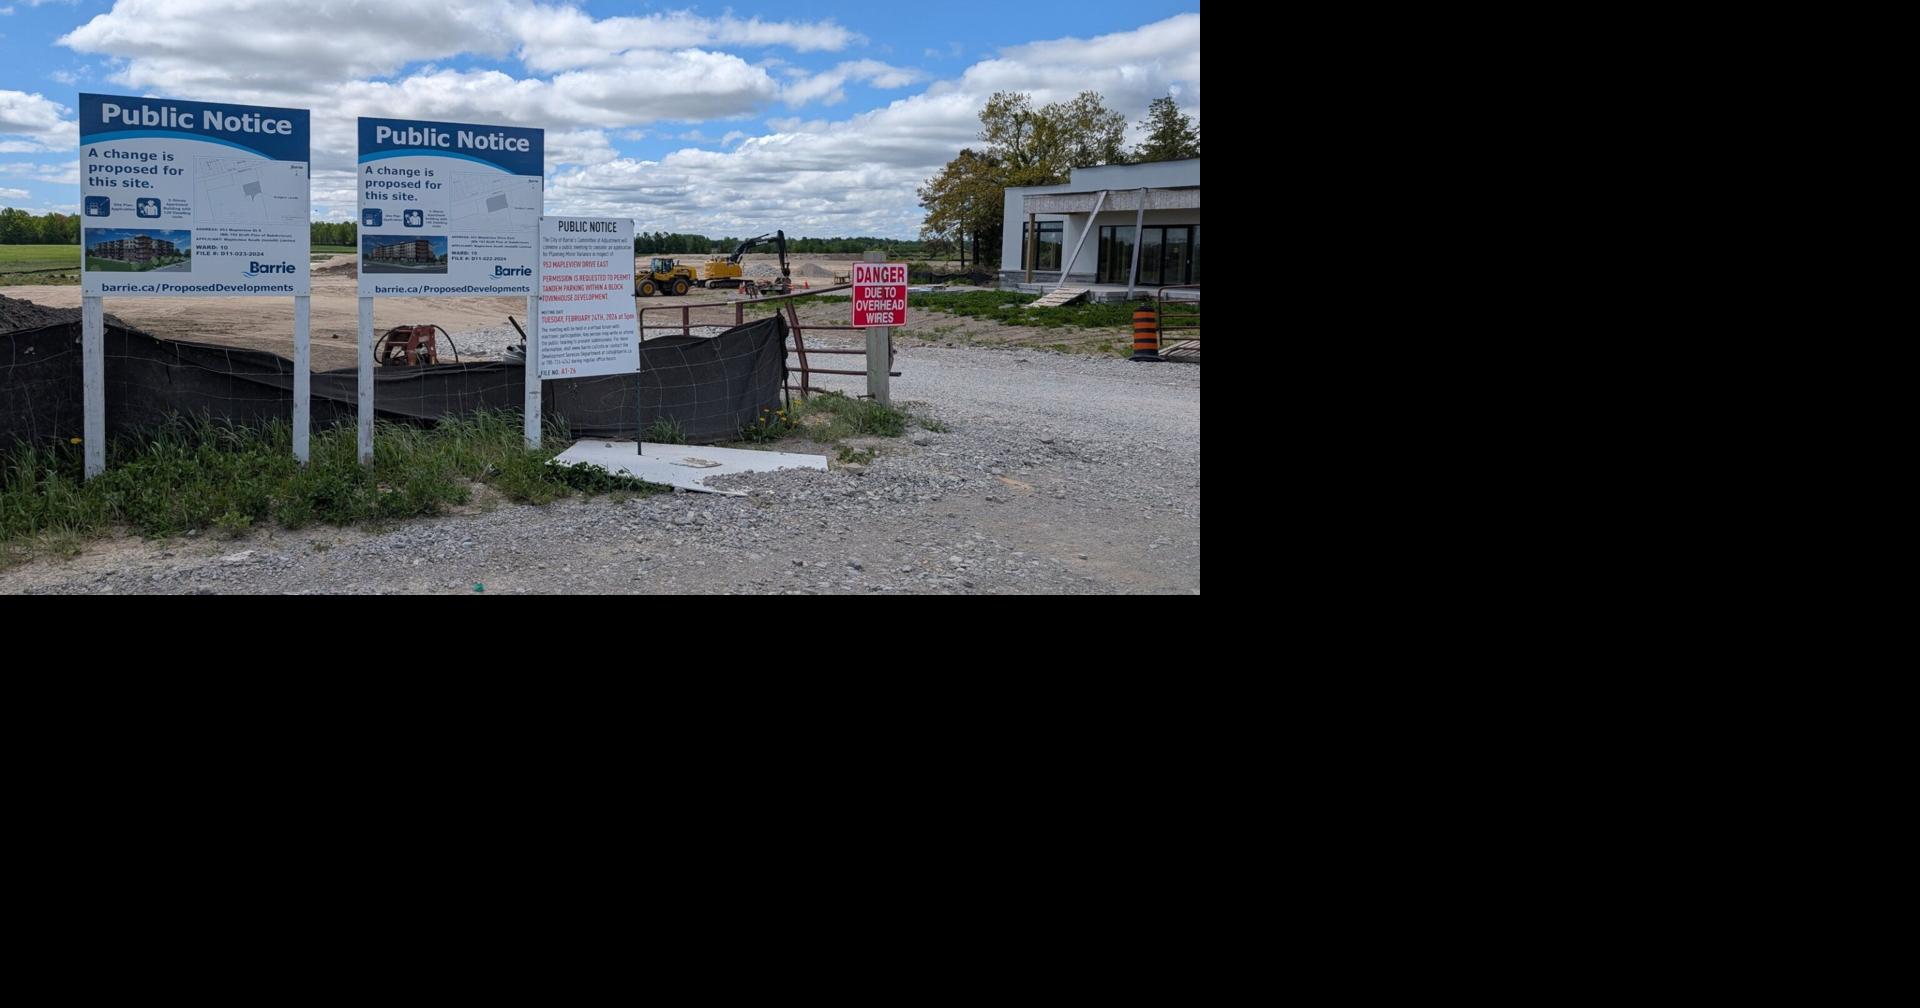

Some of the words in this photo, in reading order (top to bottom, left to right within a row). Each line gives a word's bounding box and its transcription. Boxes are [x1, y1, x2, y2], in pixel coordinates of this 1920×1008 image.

[102, 103, 194, 128] Public
[204, 111, 292, 135] Notice
[376, 126, 450, 147] Public
[458, 130, 530, 152] Notice
[88, 148, 98, 158] A
[104, 148, 158, 162] change
[162, 151, 174, 161] is
[89, 162, 158, 178] proposed
[163, 165, 184, 176] for
[365, 166, 373, 174] A
[377, 166, 420, 178] change
[425, 168, 434, 177] is
[89, 176, 117, 187] this
[122, 178, 154, 189] site.
[365, 178, 421, 192] proposed
[425, 180, 442, 189] for
[365, 192, 389, 201] this
[392, 192, 418, 201] site.
[558, 221, 587, 232] PUBLIC
[590, 222, 617, 232] NOTICE
[250, 261, 296, 274] Barrie
[495, 265, 532, 276] Barrie
[856, 266, 904, 283] DANGER
[102, 282, 294, 294] barrie.ca/ProposedDevelopments
[375, 284, 530, 294] barrie.ca/ProposedDevelopments
[865, 287, 882, 298] DUE
[885, 287, 896, 297] TO
[856, 300, 904, 311] OVERHEAD
[866, 312, 894, 323] WIRES
